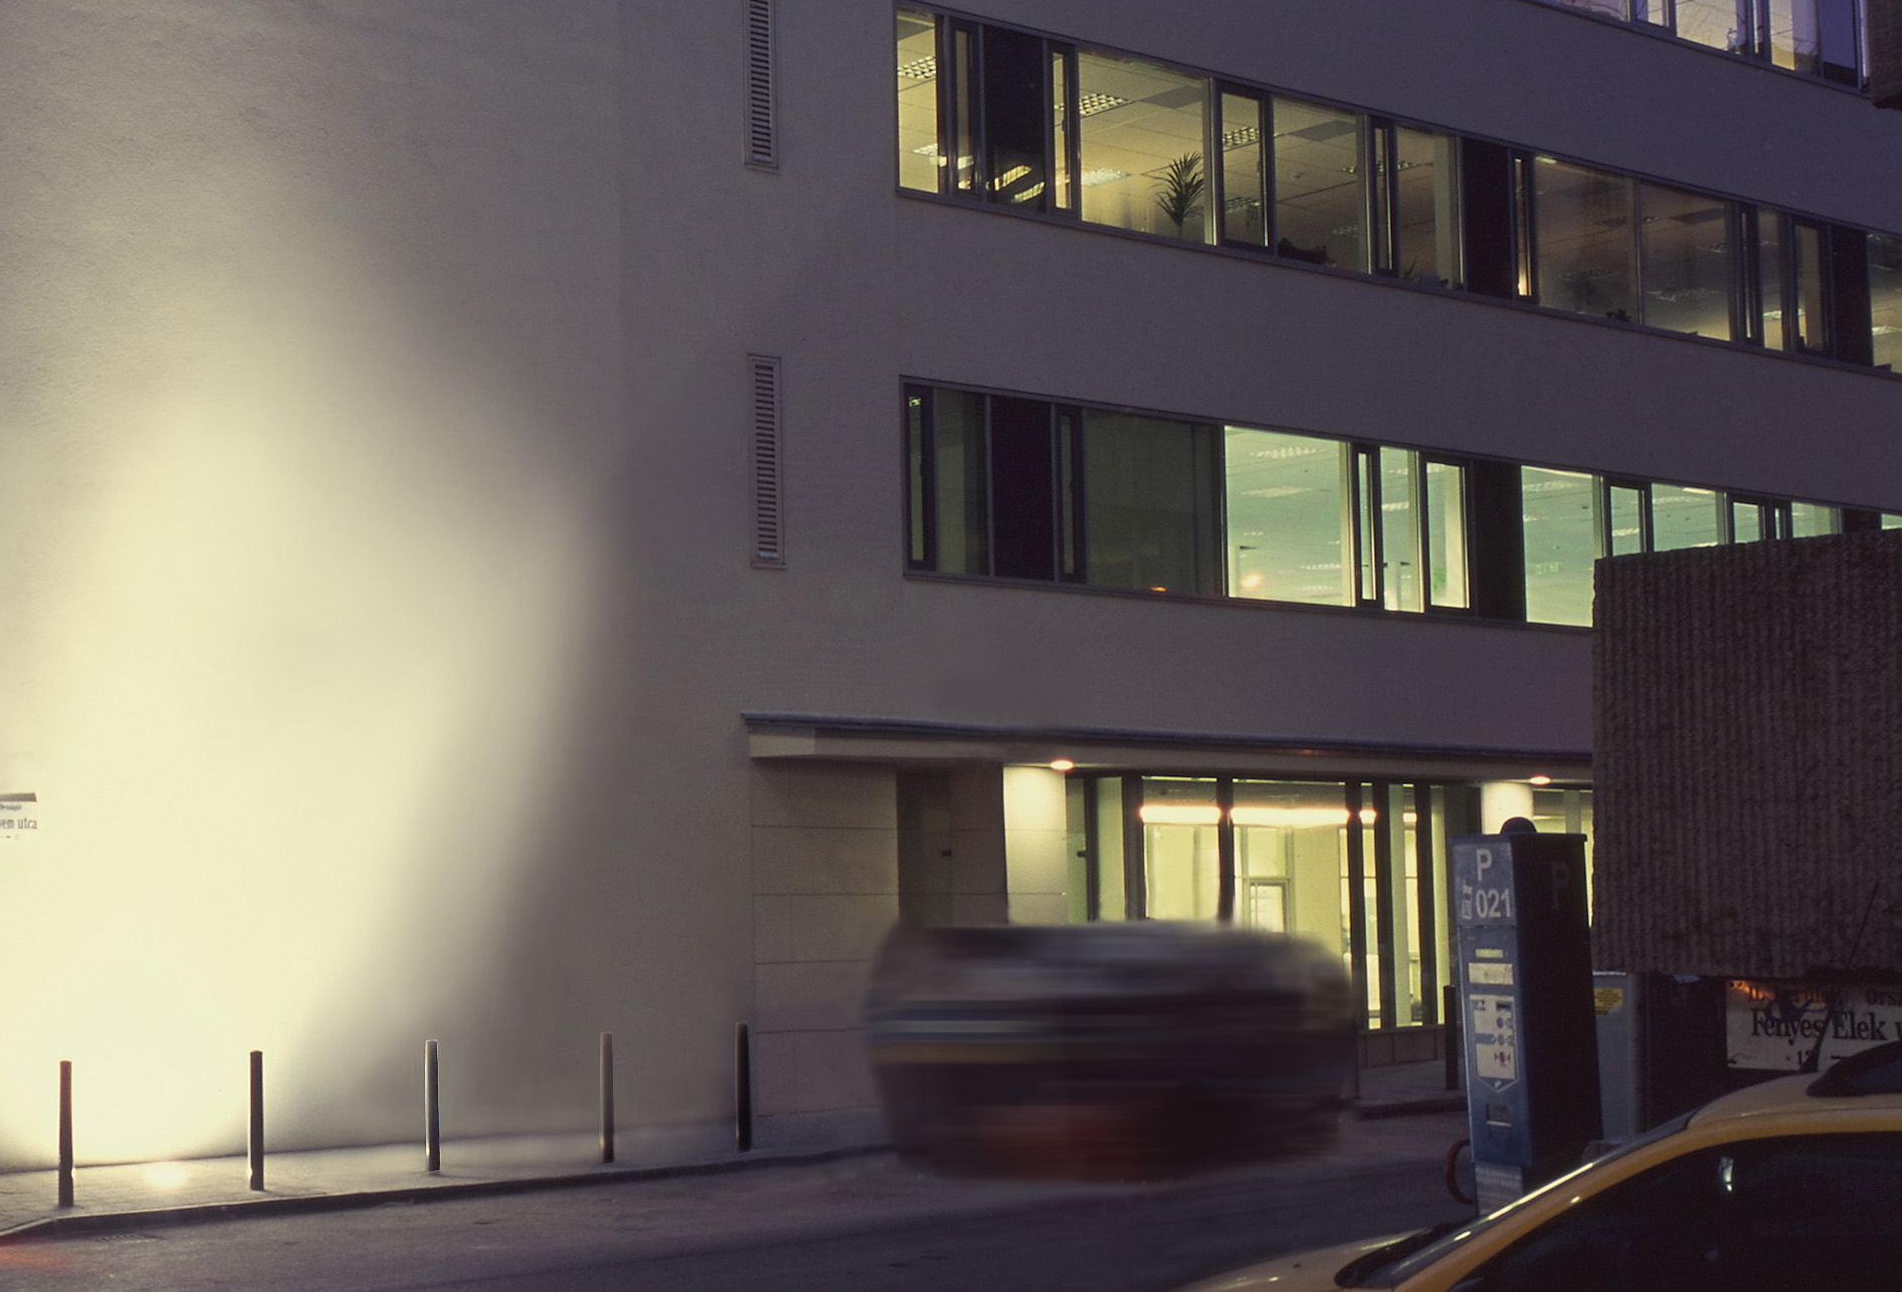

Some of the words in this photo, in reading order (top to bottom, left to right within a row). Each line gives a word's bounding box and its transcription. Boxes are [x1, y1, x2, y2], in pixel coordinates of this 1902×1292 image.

[17, 818, 38, 830] utca
[1476, 848, 1493, 882] P
[1476, 888, 1511, 919] 021
[1833, 1009, 1888, 1041] Elek
